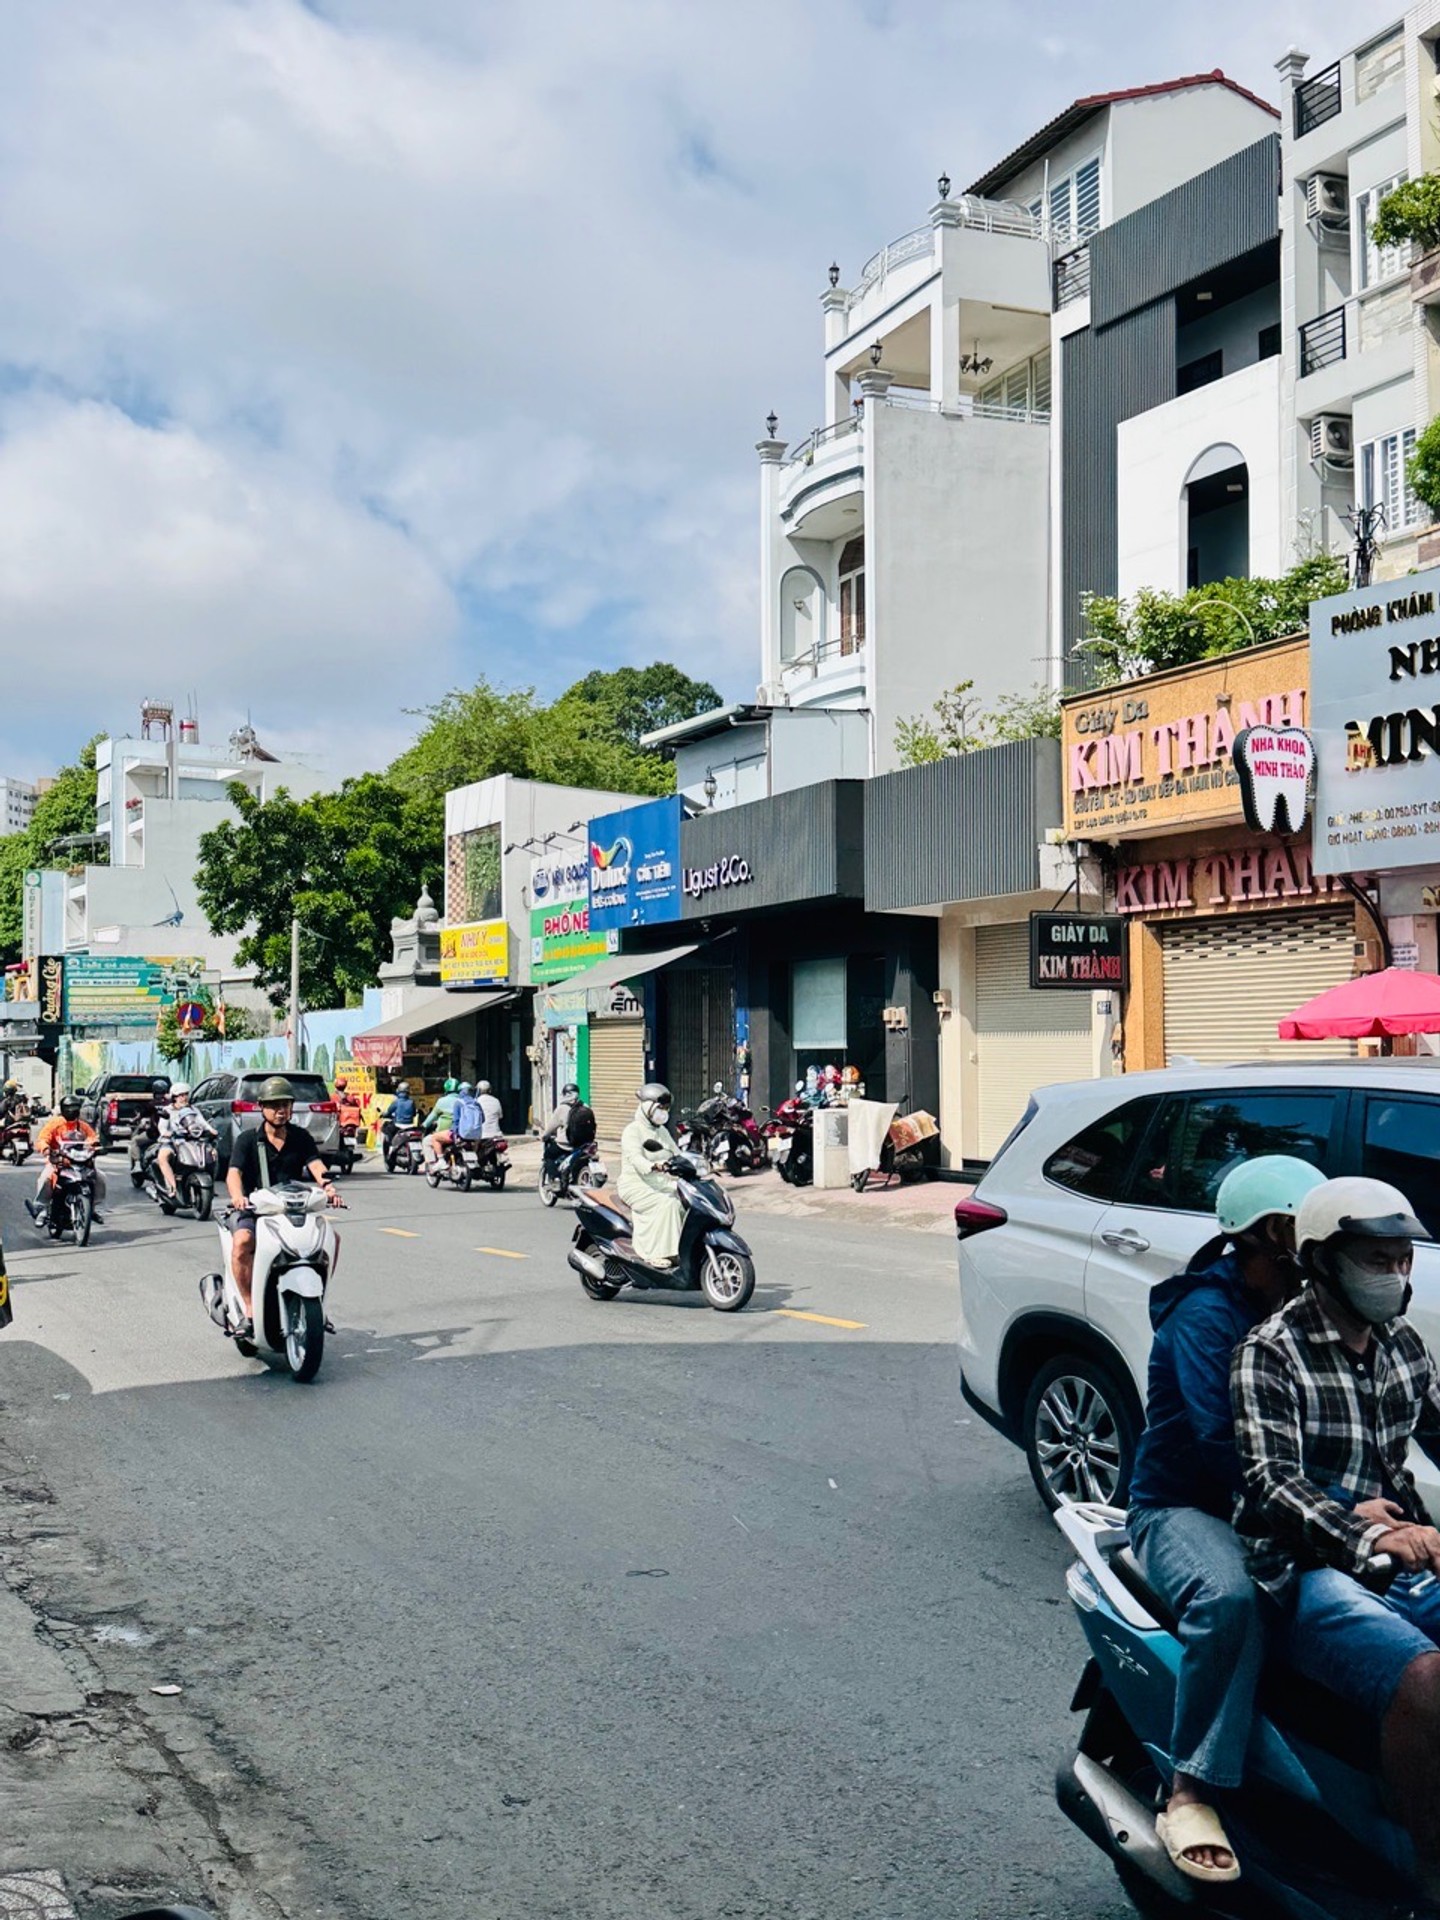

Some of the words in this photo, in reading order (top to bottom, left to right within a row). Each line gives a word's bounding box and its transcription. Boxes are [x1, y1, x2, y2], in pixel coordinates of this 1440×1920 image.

[1331, 605, 1382, 637] PHÒNG
[1122, 700, 1149, 724] Da
[1068, 731, 1144, 792] KIM
[1251, 737, 1274, 753] NHA
[1277, 738, 1306, 757] KHOA
[1254, 760, 1278, 777] MINH
[1116, 862, 1192, 913] KIM
[545, 901, 571, 934] PHỐ
[1051, 921, 1085, 943] GIÀY
[1089, 926, 1109, 943] DA
[1039, 955, 1067, 978] KIM
[1071, 950, 1121, 979] THÀNH
